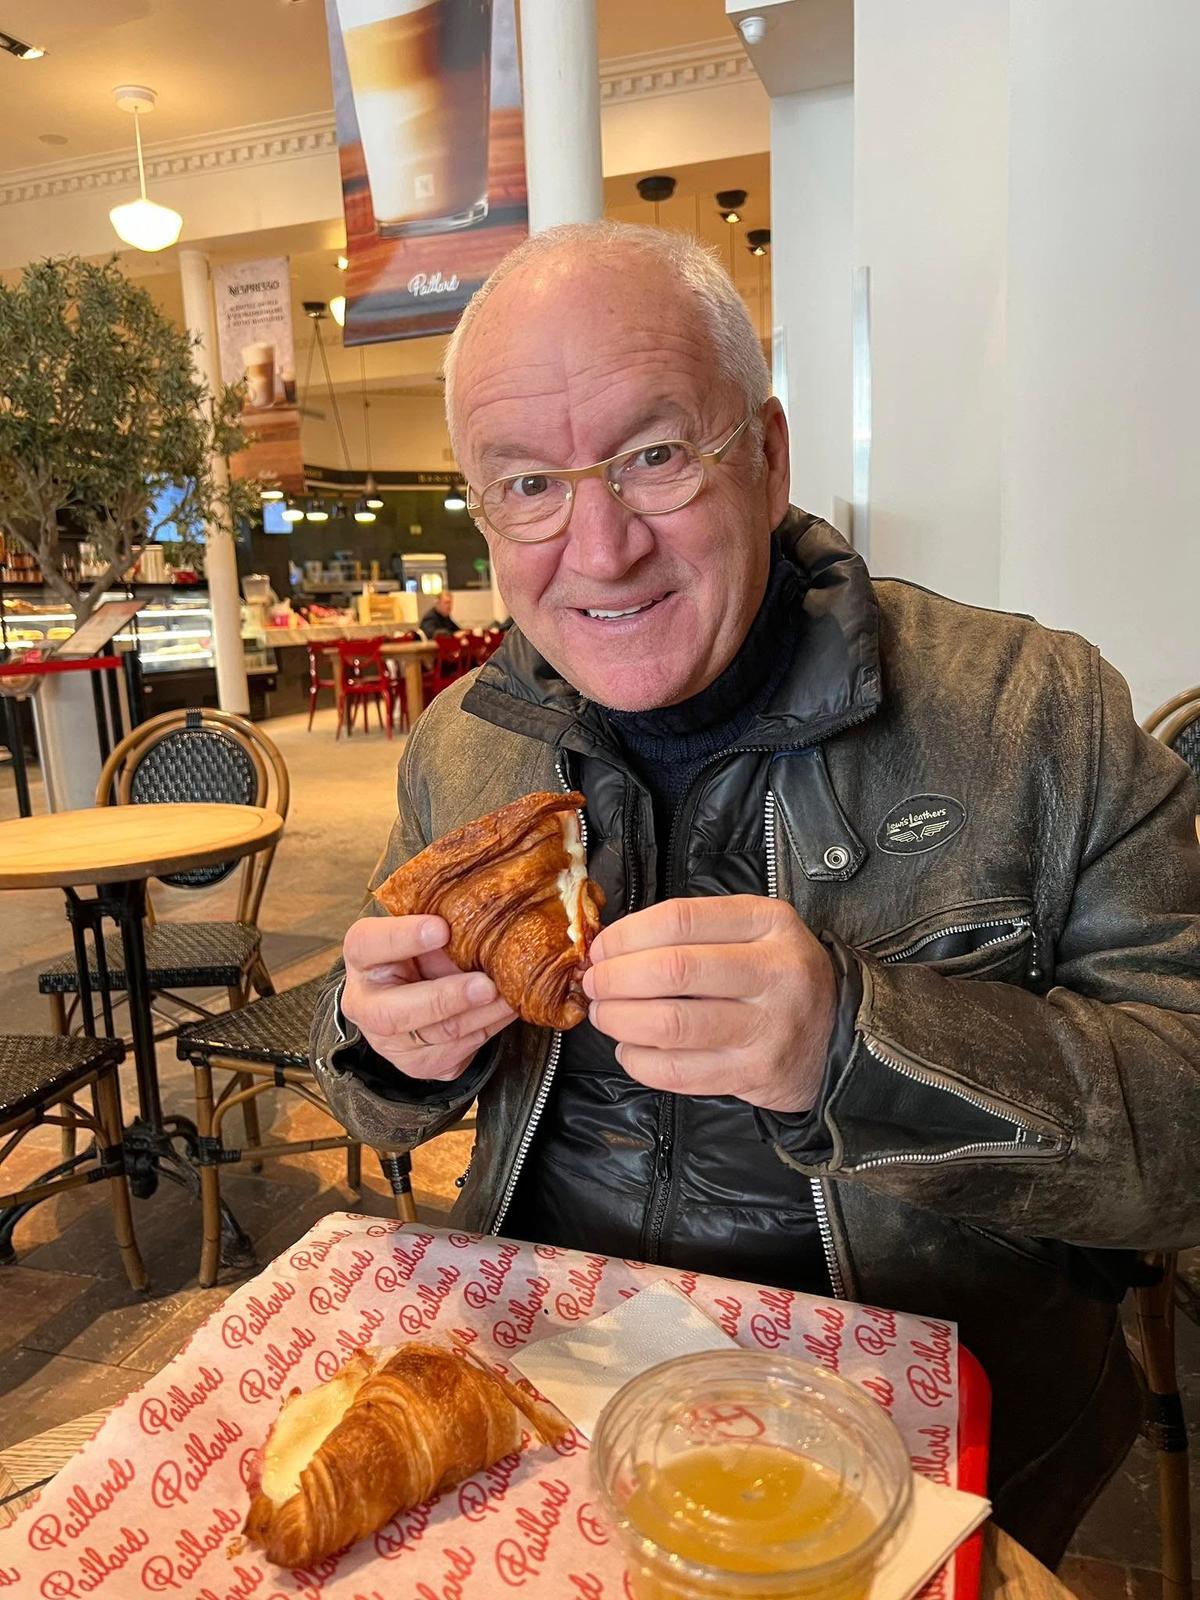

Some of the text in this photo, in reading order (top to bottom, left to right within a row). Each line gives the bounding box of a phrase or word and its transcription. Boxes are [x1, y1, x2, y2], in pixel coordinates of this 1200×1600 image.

[228, 280, 280, 297] NESPRESSO
[407, 272, 460, 297] Paillard
[886, 808, 947, 836] Lewis Leathers
[290, 1229, 353, 1271] Paillard
[309, 1250, 374, 1315] Paillard
[375, 1232, 435, 1293] Paillard
[464, 1243, 521, 1309] Paillard
[222, 1281, 296, 1349] Paillard
[400, 1265, 461, 1335] Paillard
[493, 1276, 551, 1349] Paillard
[555, 1255, 609, 1321] Paillard
[239, 1327, 316, 1404] Paillard
[906, 1320, 953, 1407] Paillard
[139, 1366, 224, 1435] Paillard
[151, 1418, 243, 1508] Paillard
[28, 1458, 135, 1551] Paillard
[495, 1479, 571, 1587] Paillard
[40, 1527, 149, 1600] Paillard
[141, 1508, 242, 1592] Paillard
